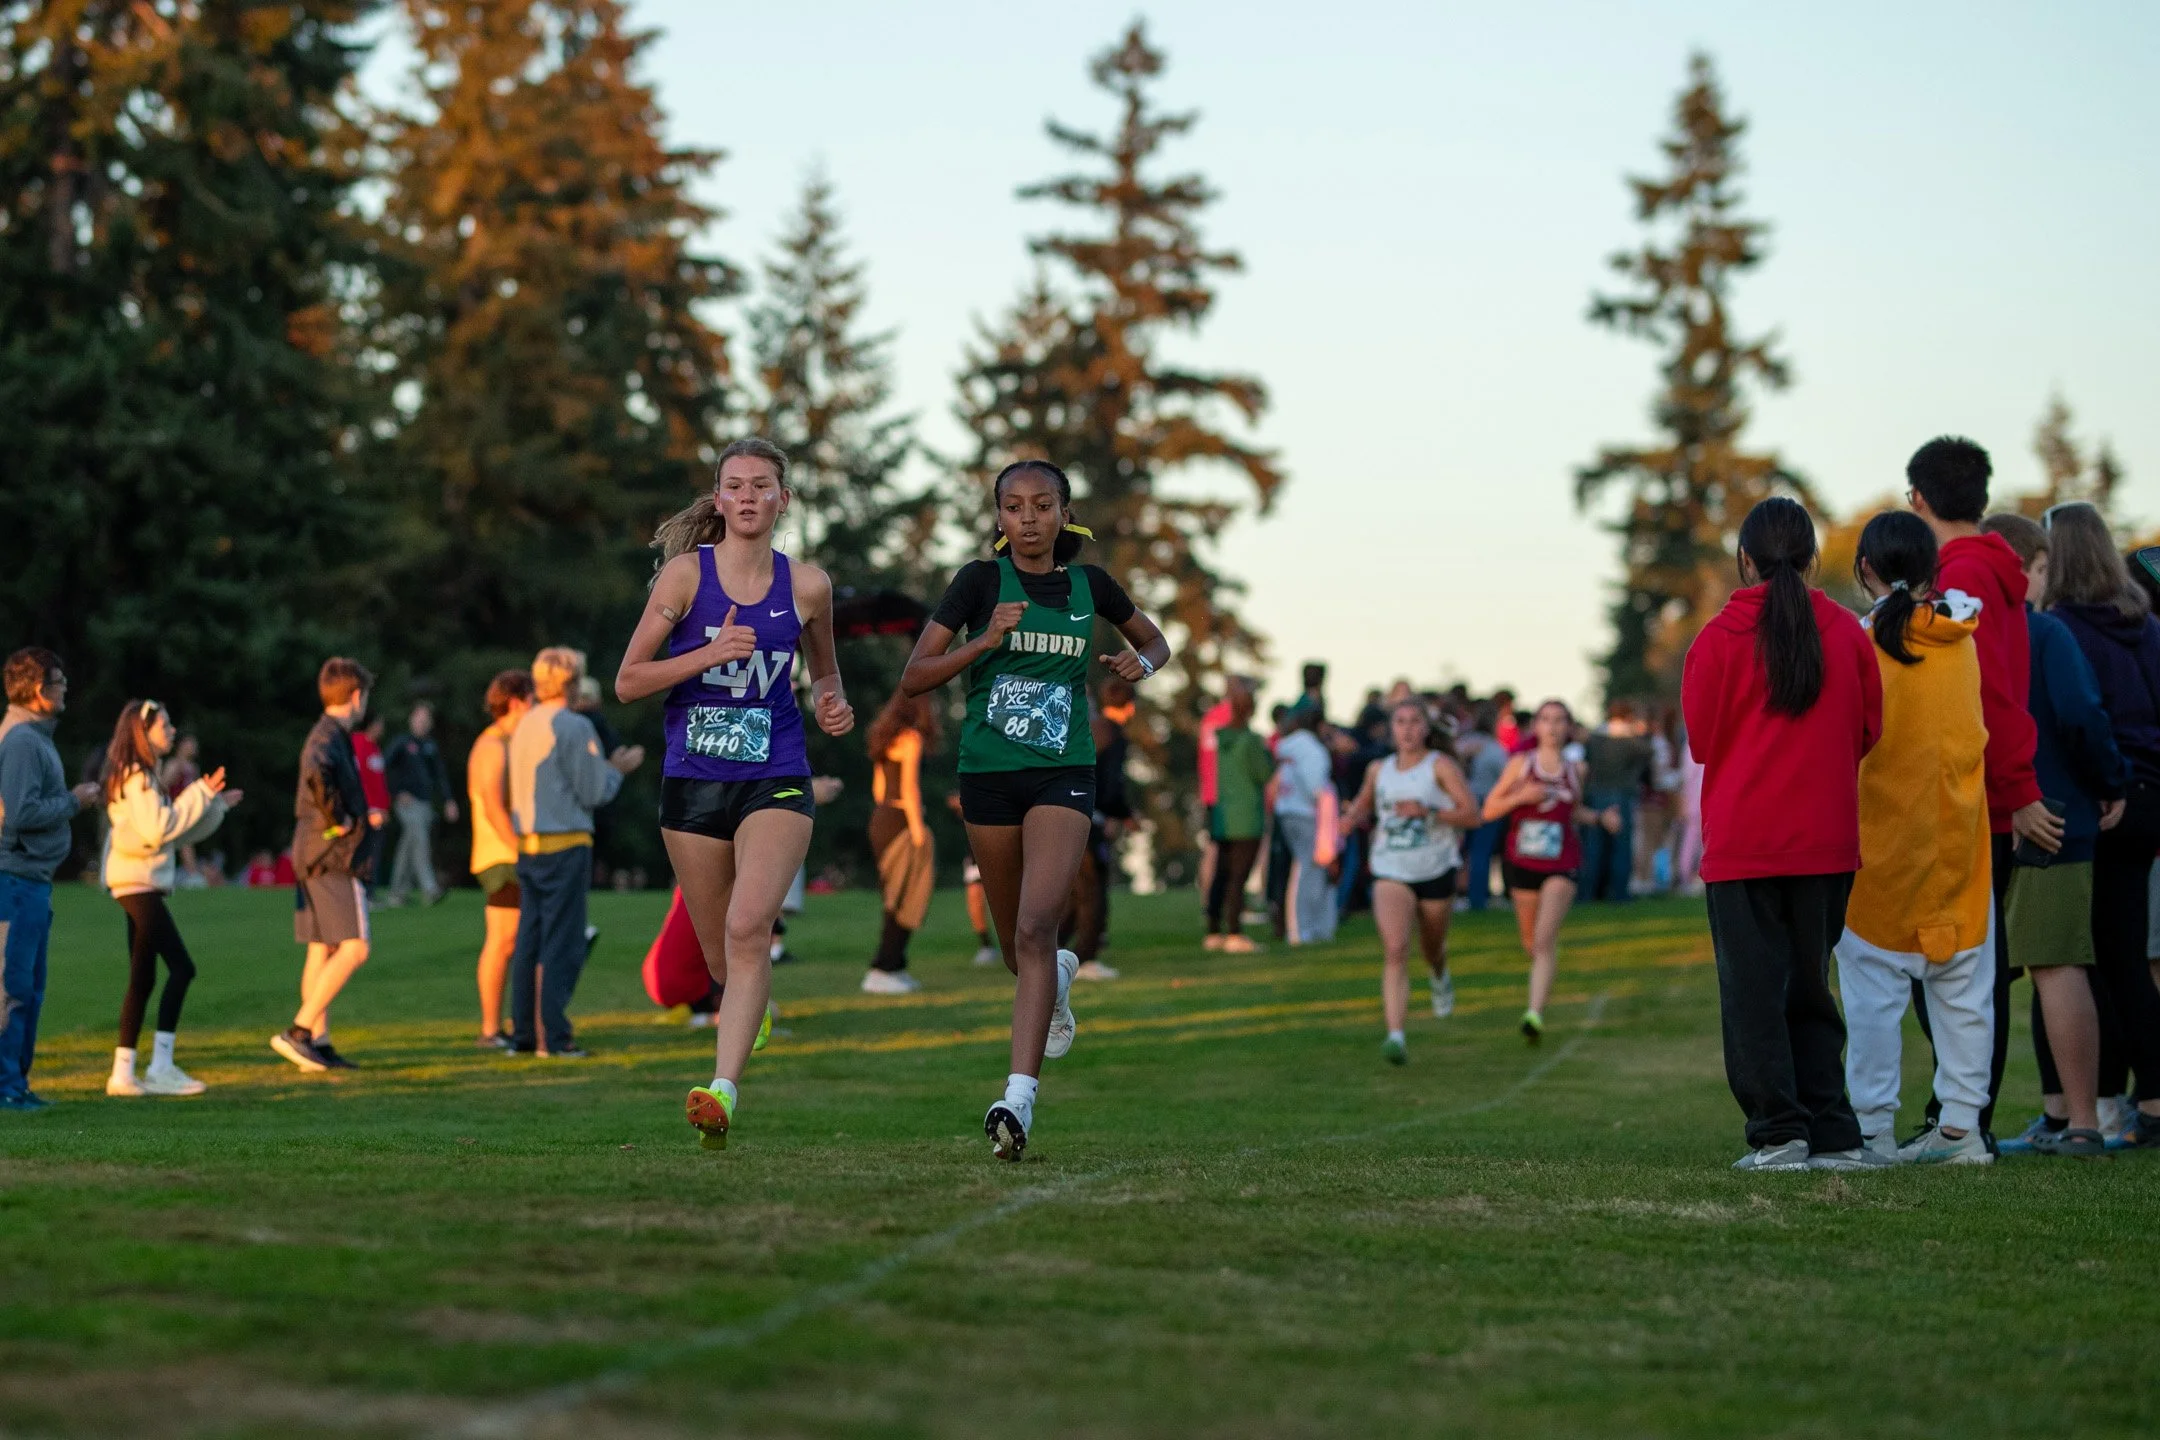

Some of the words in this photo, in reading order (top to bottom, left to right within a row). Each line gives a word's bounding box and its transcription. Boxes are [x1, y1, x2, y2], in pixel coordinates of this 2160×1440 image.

[1009, 631, 1086, 658] AUBURN
[998, 680, 1047, 698] TWILIGHT
[1003, 693, 1029, 707] XC
[703, 710, 726, 725] XC
[1004, 716, 1029, 737] 88
[695, 733, 740, 756] 1440
